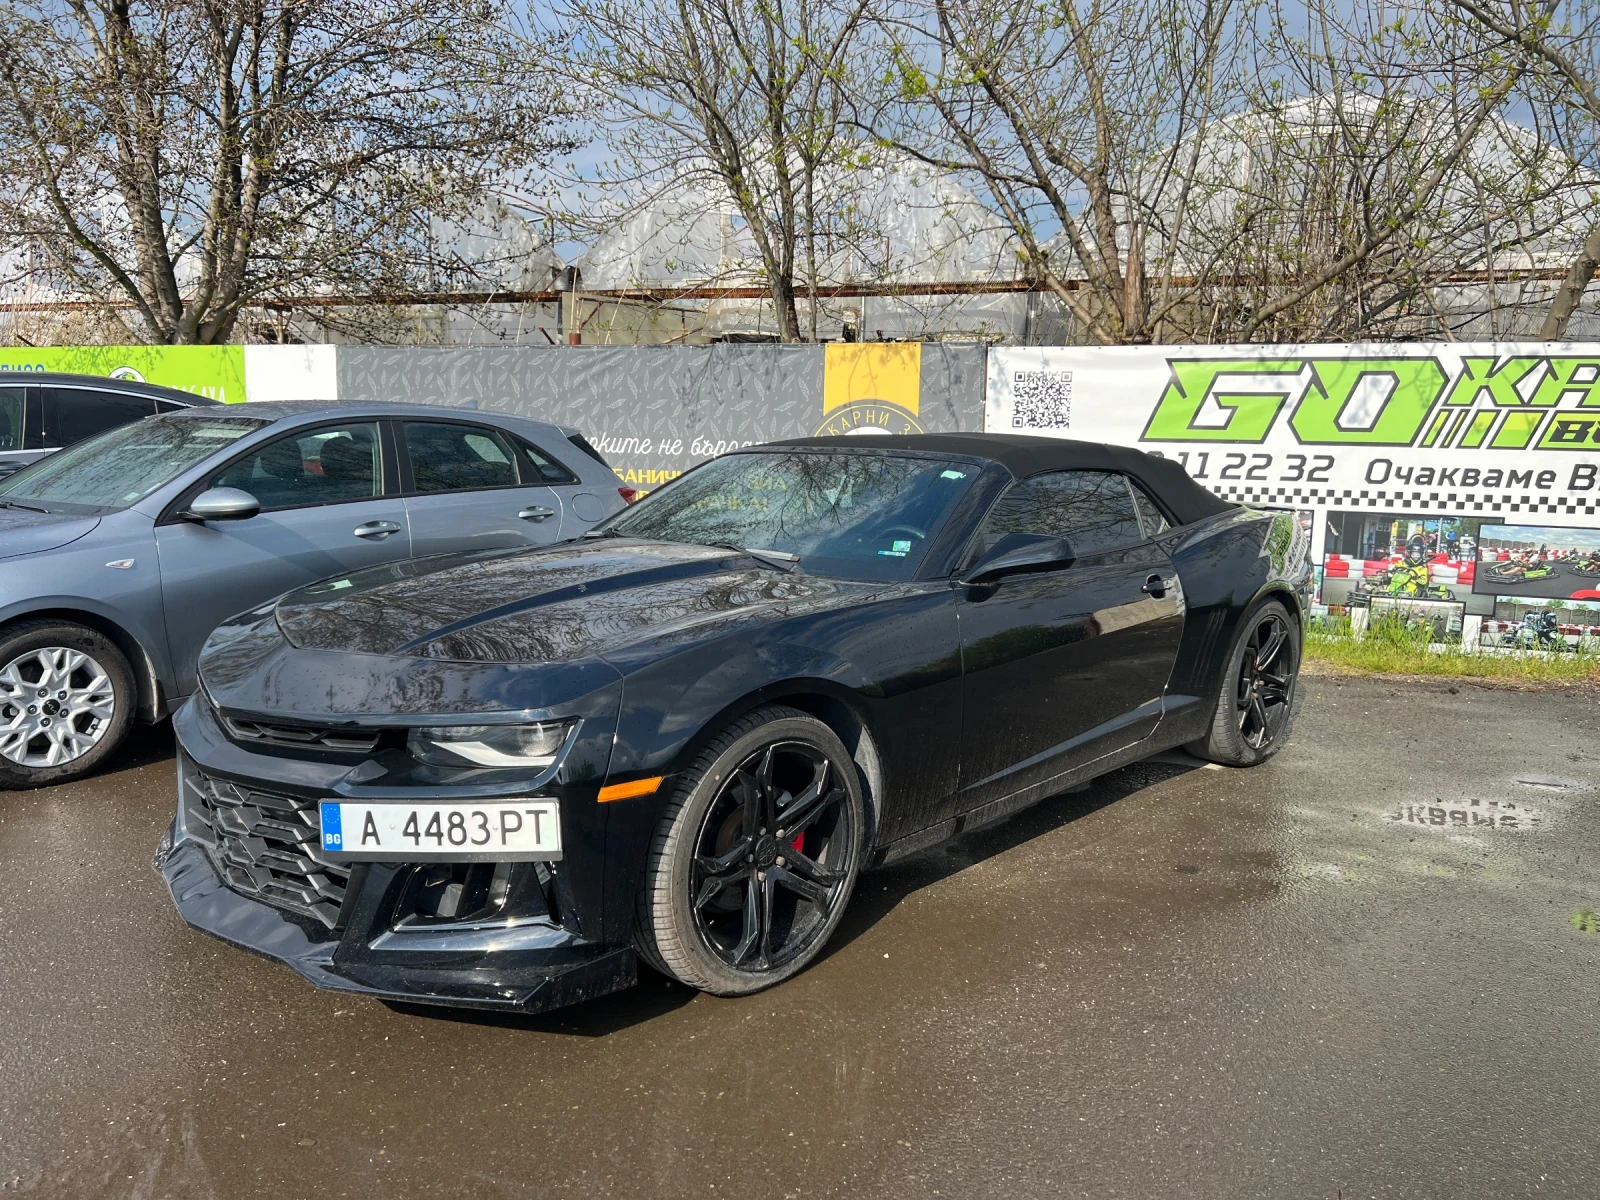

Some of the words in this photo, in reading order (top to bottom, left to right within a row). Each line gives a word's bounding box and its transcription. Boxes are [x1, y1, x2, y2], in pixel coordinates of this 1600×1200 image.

[820, 410, 889, 437] КАРНИ
[658, 438, 683, 455] не
[612, 468, 683, 485] БАНИЧ
[1219, 452, 1273, 480] 22
[1279, 454, 1335, 483] 32
[1364, 458, 1557, 490] Очакваме
[325, 833, 341, 845] BG
[361, 810, 381, 846] A
[402, 810, 491, 847] 4483
[499, 809, 548, 846] PT
